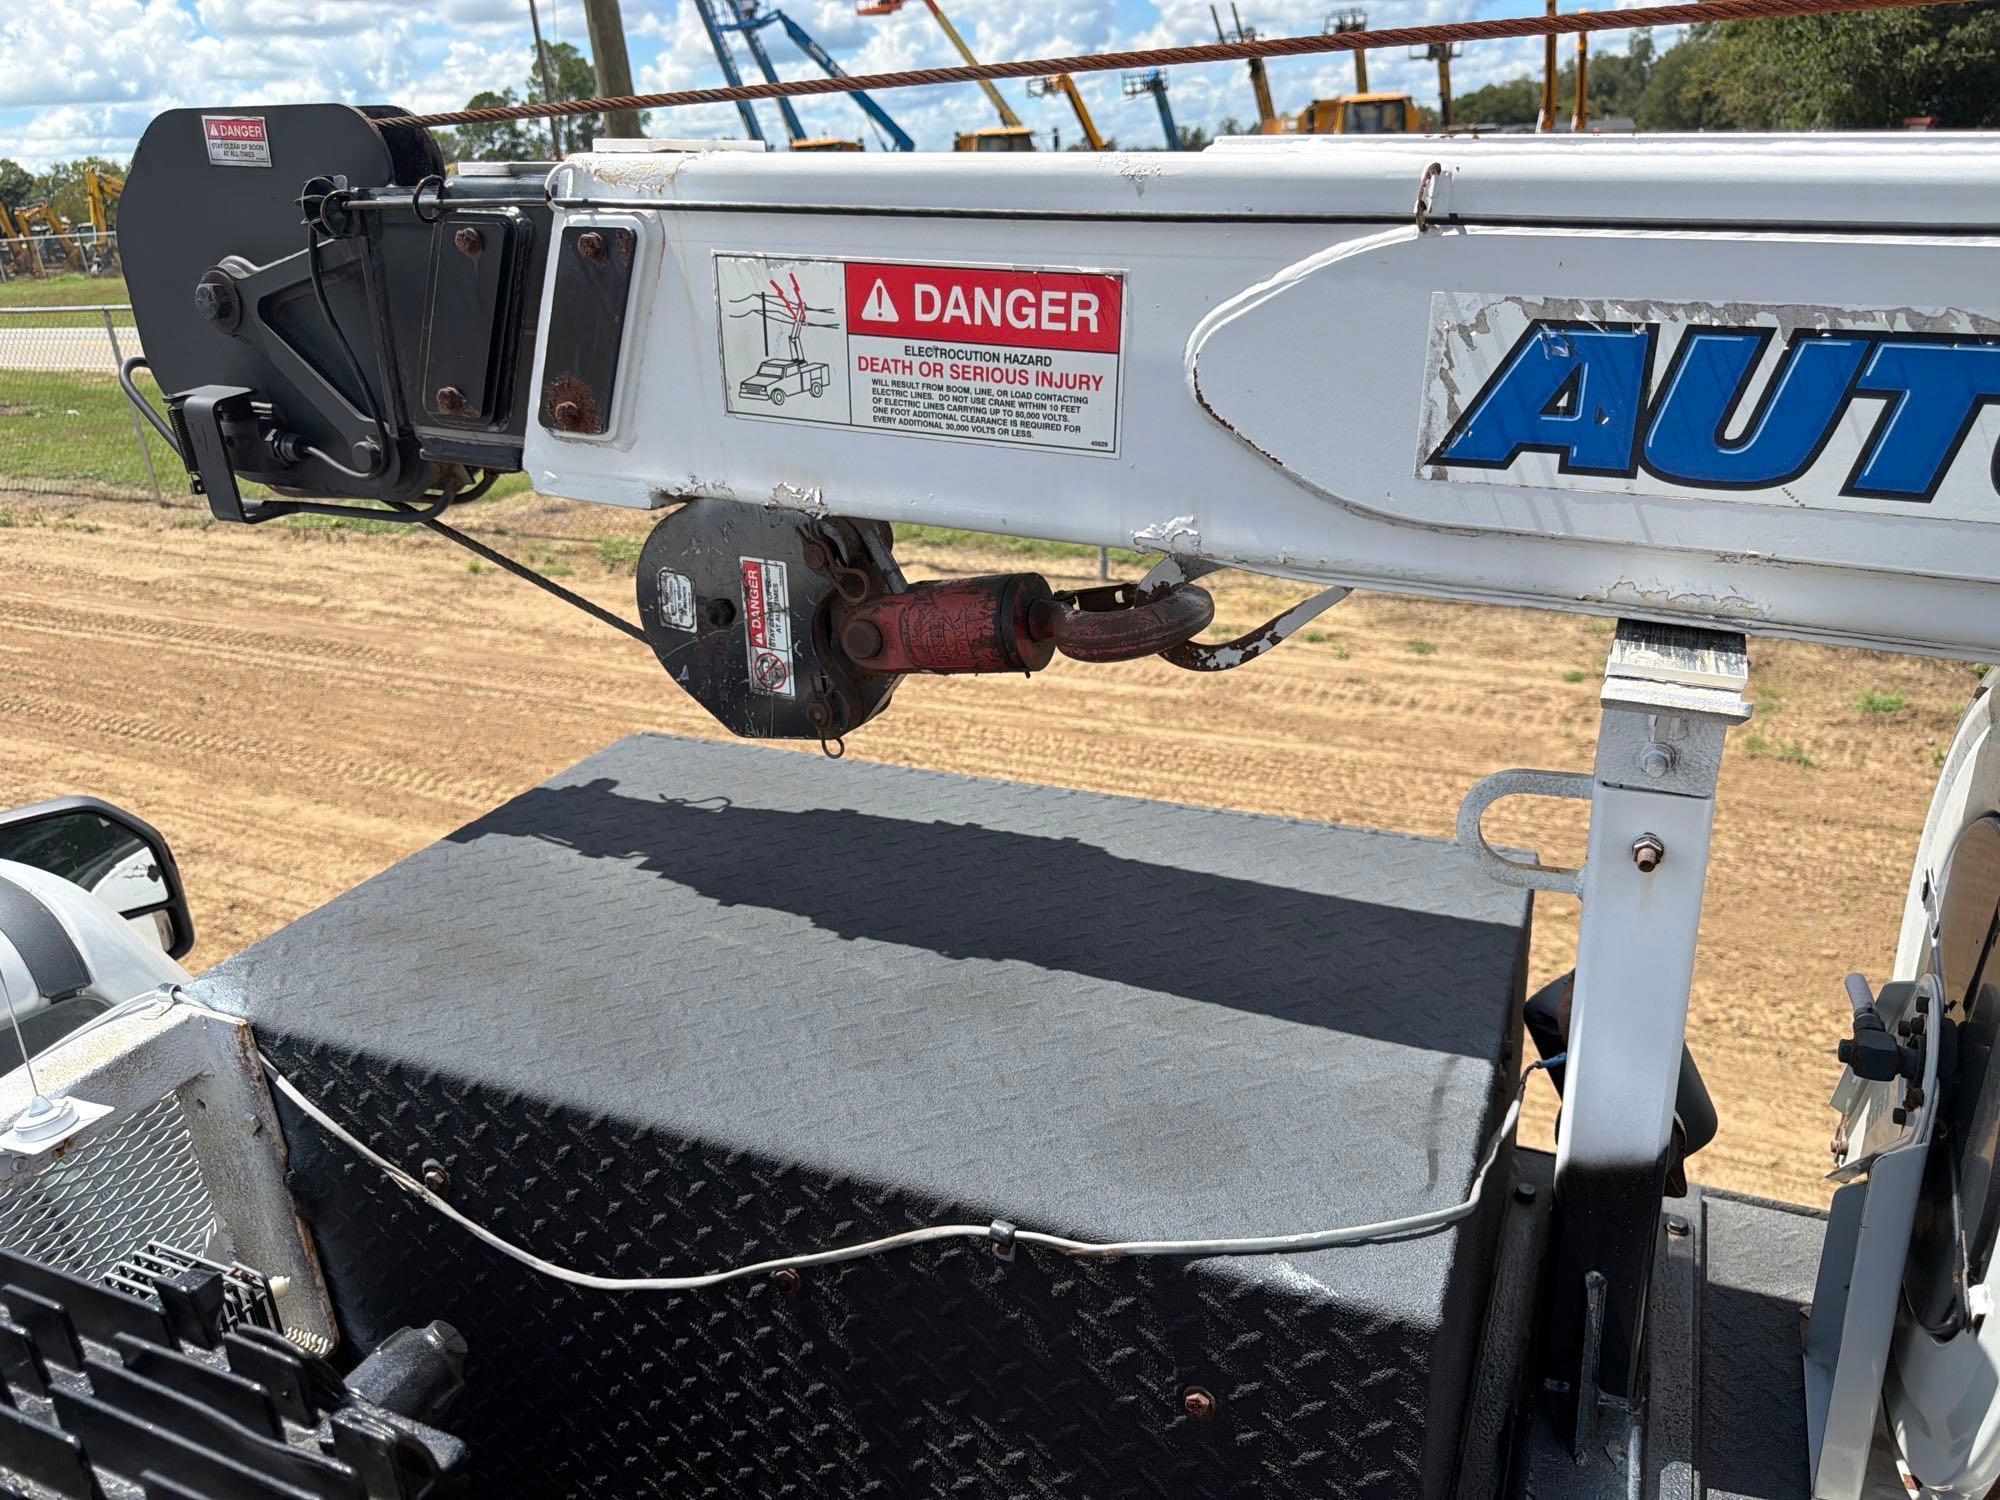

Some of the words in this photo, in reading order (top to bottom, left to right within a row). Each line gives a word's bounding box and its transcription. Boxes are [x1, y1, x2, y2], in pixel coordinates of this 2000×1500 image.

[220, 125, 262, 138] DANGER
[914, 283, 1100, 333] DANGER
[904, 345, 1000, 363] ELECTROCUTION
[1004, 353, 1052, 367] HAZARD
[858, 356, 913, 376] DEATH
[919, 361, 944, 378] OR
[950, 363, 1029, 386] SERIOUS
[1035, 370, 1104, 392] INJURY
[872, 378, 890, 387] WILL
[891, 380, 920, 390] RESULT
[921, 383, 944, 392] FROM
[946, 385, 973, 396] BOOM,
[974, 387, 995, 398] LINE,
[996, 389, 1009, 397] OR
[1010, 390, 1032, 400] LOAD
[1034, 392, 1088, 404] CONTACTING
[872, 387, 909, 398] ELECTRIC
[910, 391, 935, 401] LINES.
[938, 394, 950, 402] DO
[952, 395, 969, 404] NOT
[970, 396, 987, 405] USE
[988, 398, 1016, 408] CRANE
[1018, 401, 1047, 411] WITHIN
[1050, 404, 1059, 412] 10
[1060, 405, 1081, 414] FEET
[872, 396, 883, 404] OF
[884, 398, 921, 409] ELECTRIC
[923, 401, 945, 411] LINES
[946, 404, 988, 415] CARRYING
[989, 408, 1000, 416] UP
[1002, 409, 1014, 417] TO
[1015, 411, 1040, 420] 50,000
[1042, 413, 1070, 423] VOLTS.
[872, 406, 889, 415] ONE
[890, 408, 911, 417] FOOT
[912, 410, 959, 422] ADDITIONAL
[960, 414, 1008, 427] CLEARANCE
[1010, 419, 1018, 427] IS
[1020, 420, 1062, 432] REQUIRED
[1064, 425, 1081, 433] FOR
[1424, 319, 2000, 503] AUT
[872, 415, 896, 424] EVERY
[898, 418, 944, 430] ADDITIONAL
[945, 423, 969, 432] 30,000
[971, 425, 996, 435] VOLTS
[997, 428, 1010, 436] OR
[1011, 428, 1034, 438] LESS.
[748, 570, 762, 629] DANGER
[775, 622, 782, 634] AT
